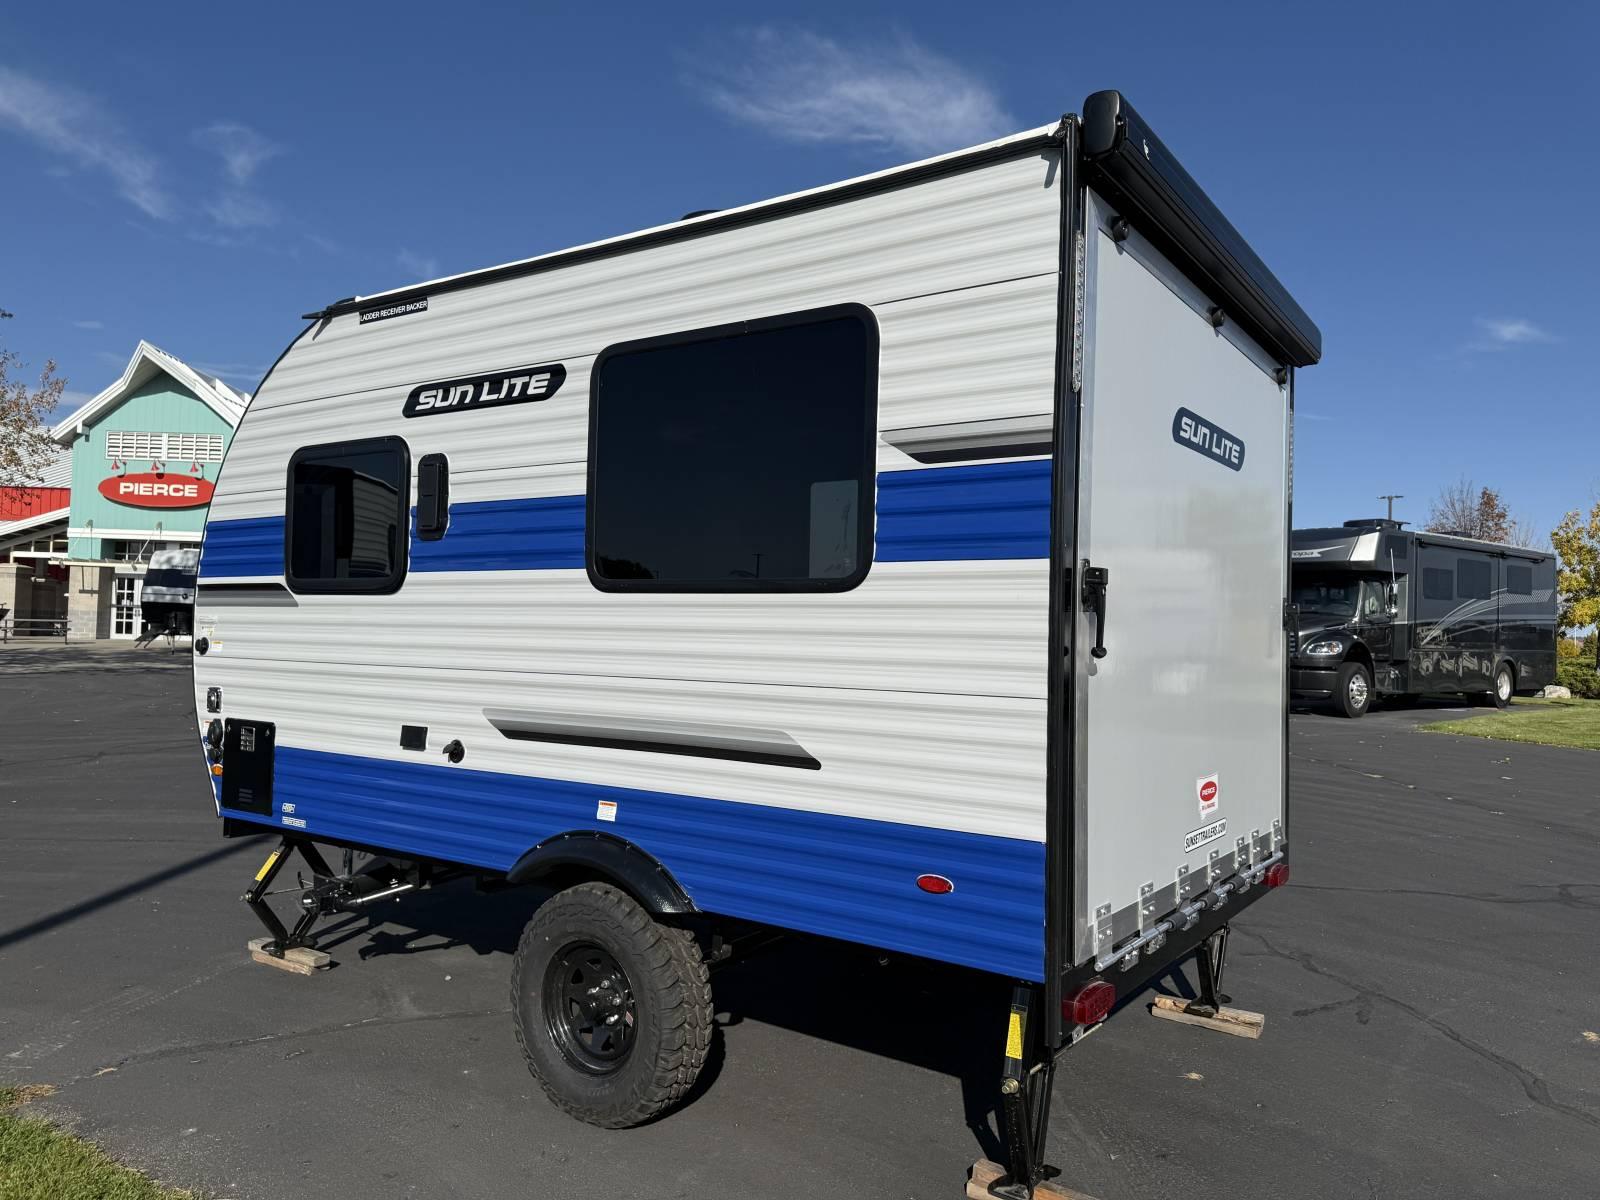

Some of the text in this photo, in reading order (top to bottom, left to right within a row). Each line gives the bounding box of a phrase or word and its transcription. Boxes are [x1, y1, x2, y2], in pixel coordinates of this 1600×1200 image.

[360, 301, 428, 321] LADDER RECEIVER BACKER
[415, 372, 551, 411] SUN LITE
[1179, 416, 1241, 465] SUN LITE
[119, 482, 198, 497] PIERCE
[1185, 821, 1227, 849] SUNSETTRAILERS.COM
